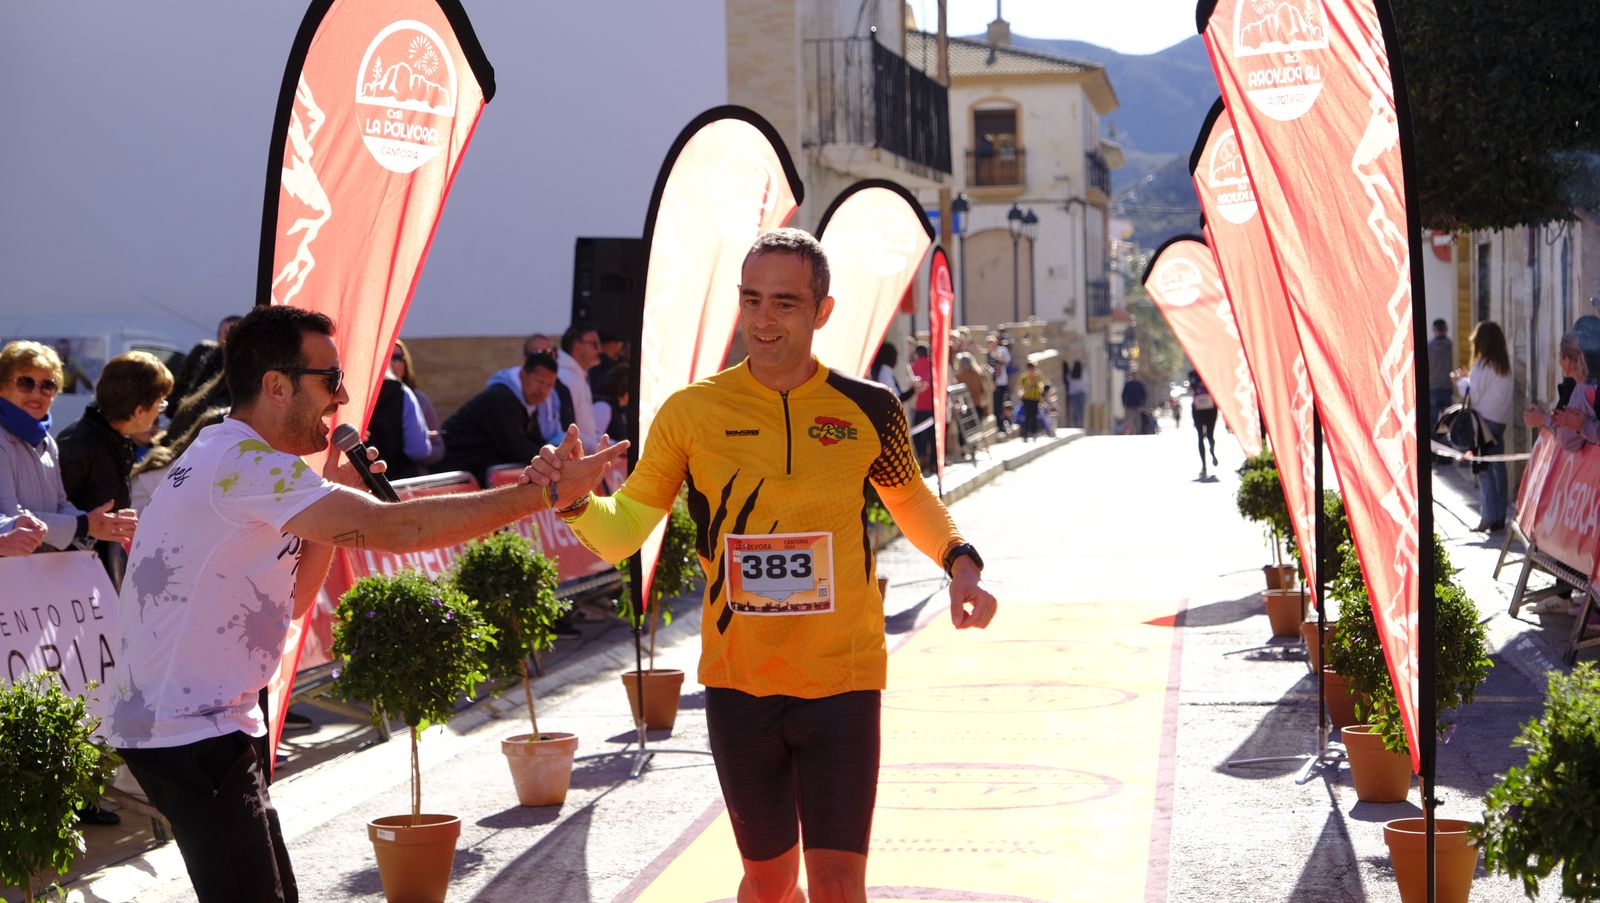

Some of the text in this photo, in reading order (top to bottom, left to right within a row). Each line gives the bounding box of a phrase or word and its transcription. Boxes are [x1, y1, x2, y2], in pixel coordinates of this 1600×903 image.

[366, 118, 381, 134] LA
[742, 553, 812, 579] 383
[71, 597, 104, 623] DE
